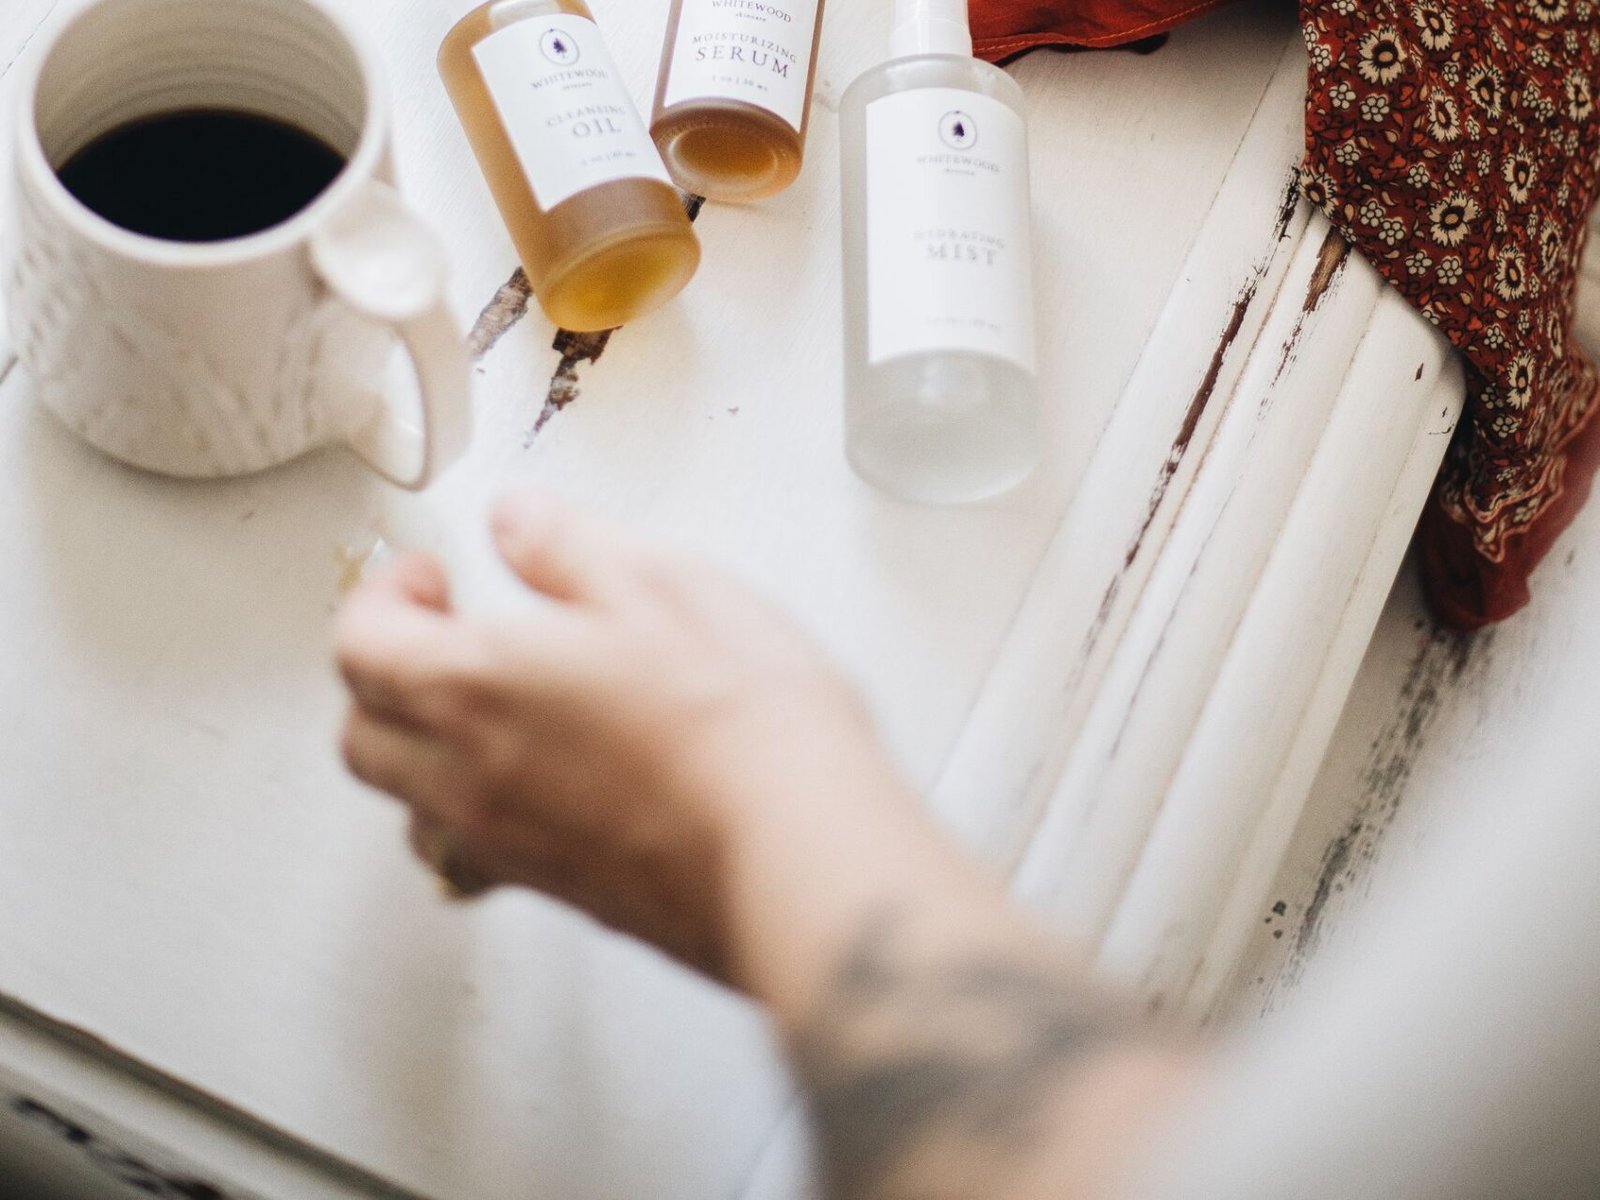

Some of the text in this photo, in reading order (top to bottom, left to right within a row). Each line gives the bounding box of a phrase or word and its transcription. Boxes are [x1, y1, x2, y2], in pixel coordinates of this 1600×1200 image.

[711, 0, 792, 24] WHITEWOOD
[692, 33, 796, 64] MOISTURIZING
[696, 45, 789, 79] SERUM
[546, 104, 627, 127] CLEANSING
[571, 117, 623, 139] OIL
[924, 242, 999, 267] MIST
